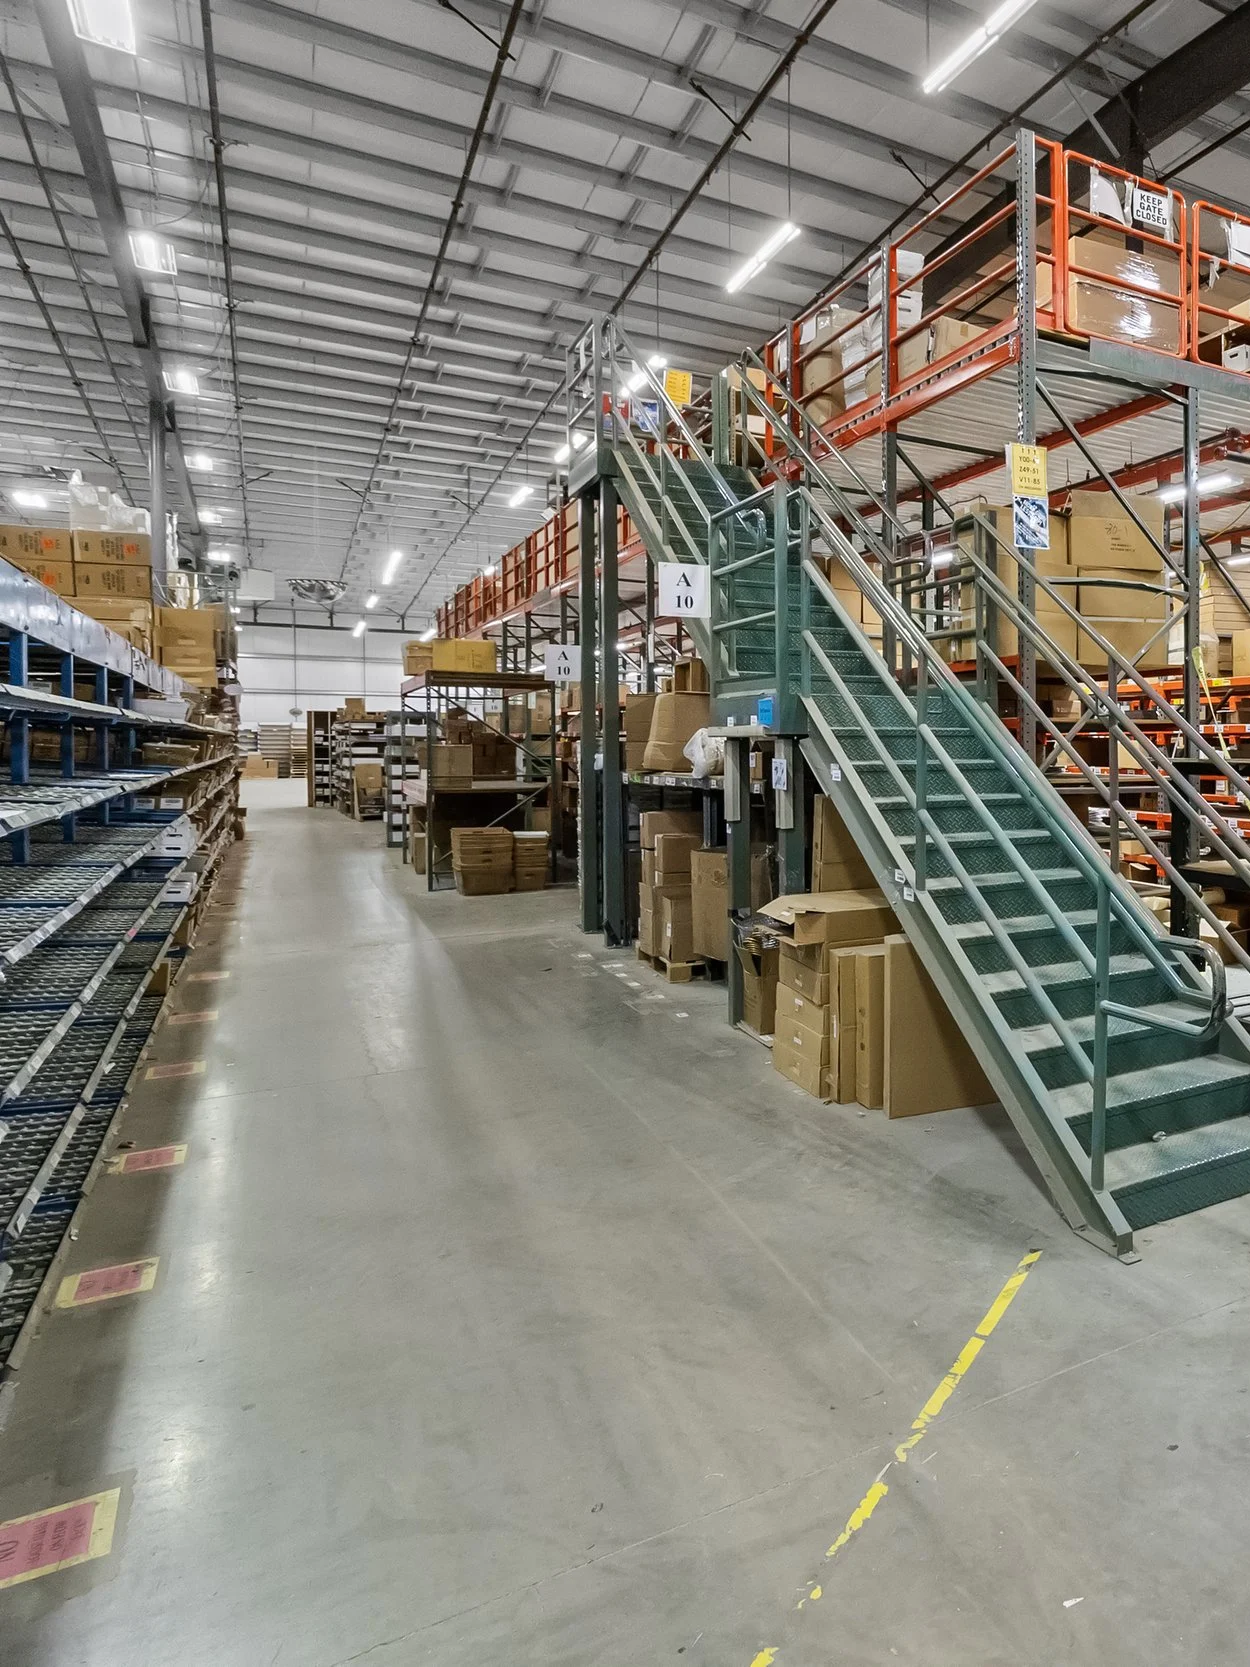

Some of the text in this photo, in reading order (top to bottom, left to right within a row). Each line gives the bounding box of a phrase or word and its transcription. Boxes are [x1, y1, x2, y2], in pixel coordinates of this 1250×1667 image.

[1140, 193, 1163, 206] KEEP
[1139, 202, 1164, 216] GATE
[1136, 209, 1168, 225] CLOSED
[676, 572, 692, 587] A
[676, 595, 694, 609] 10
[557, 650, 569, 661] A
[557, 666, 571, 675] 10
